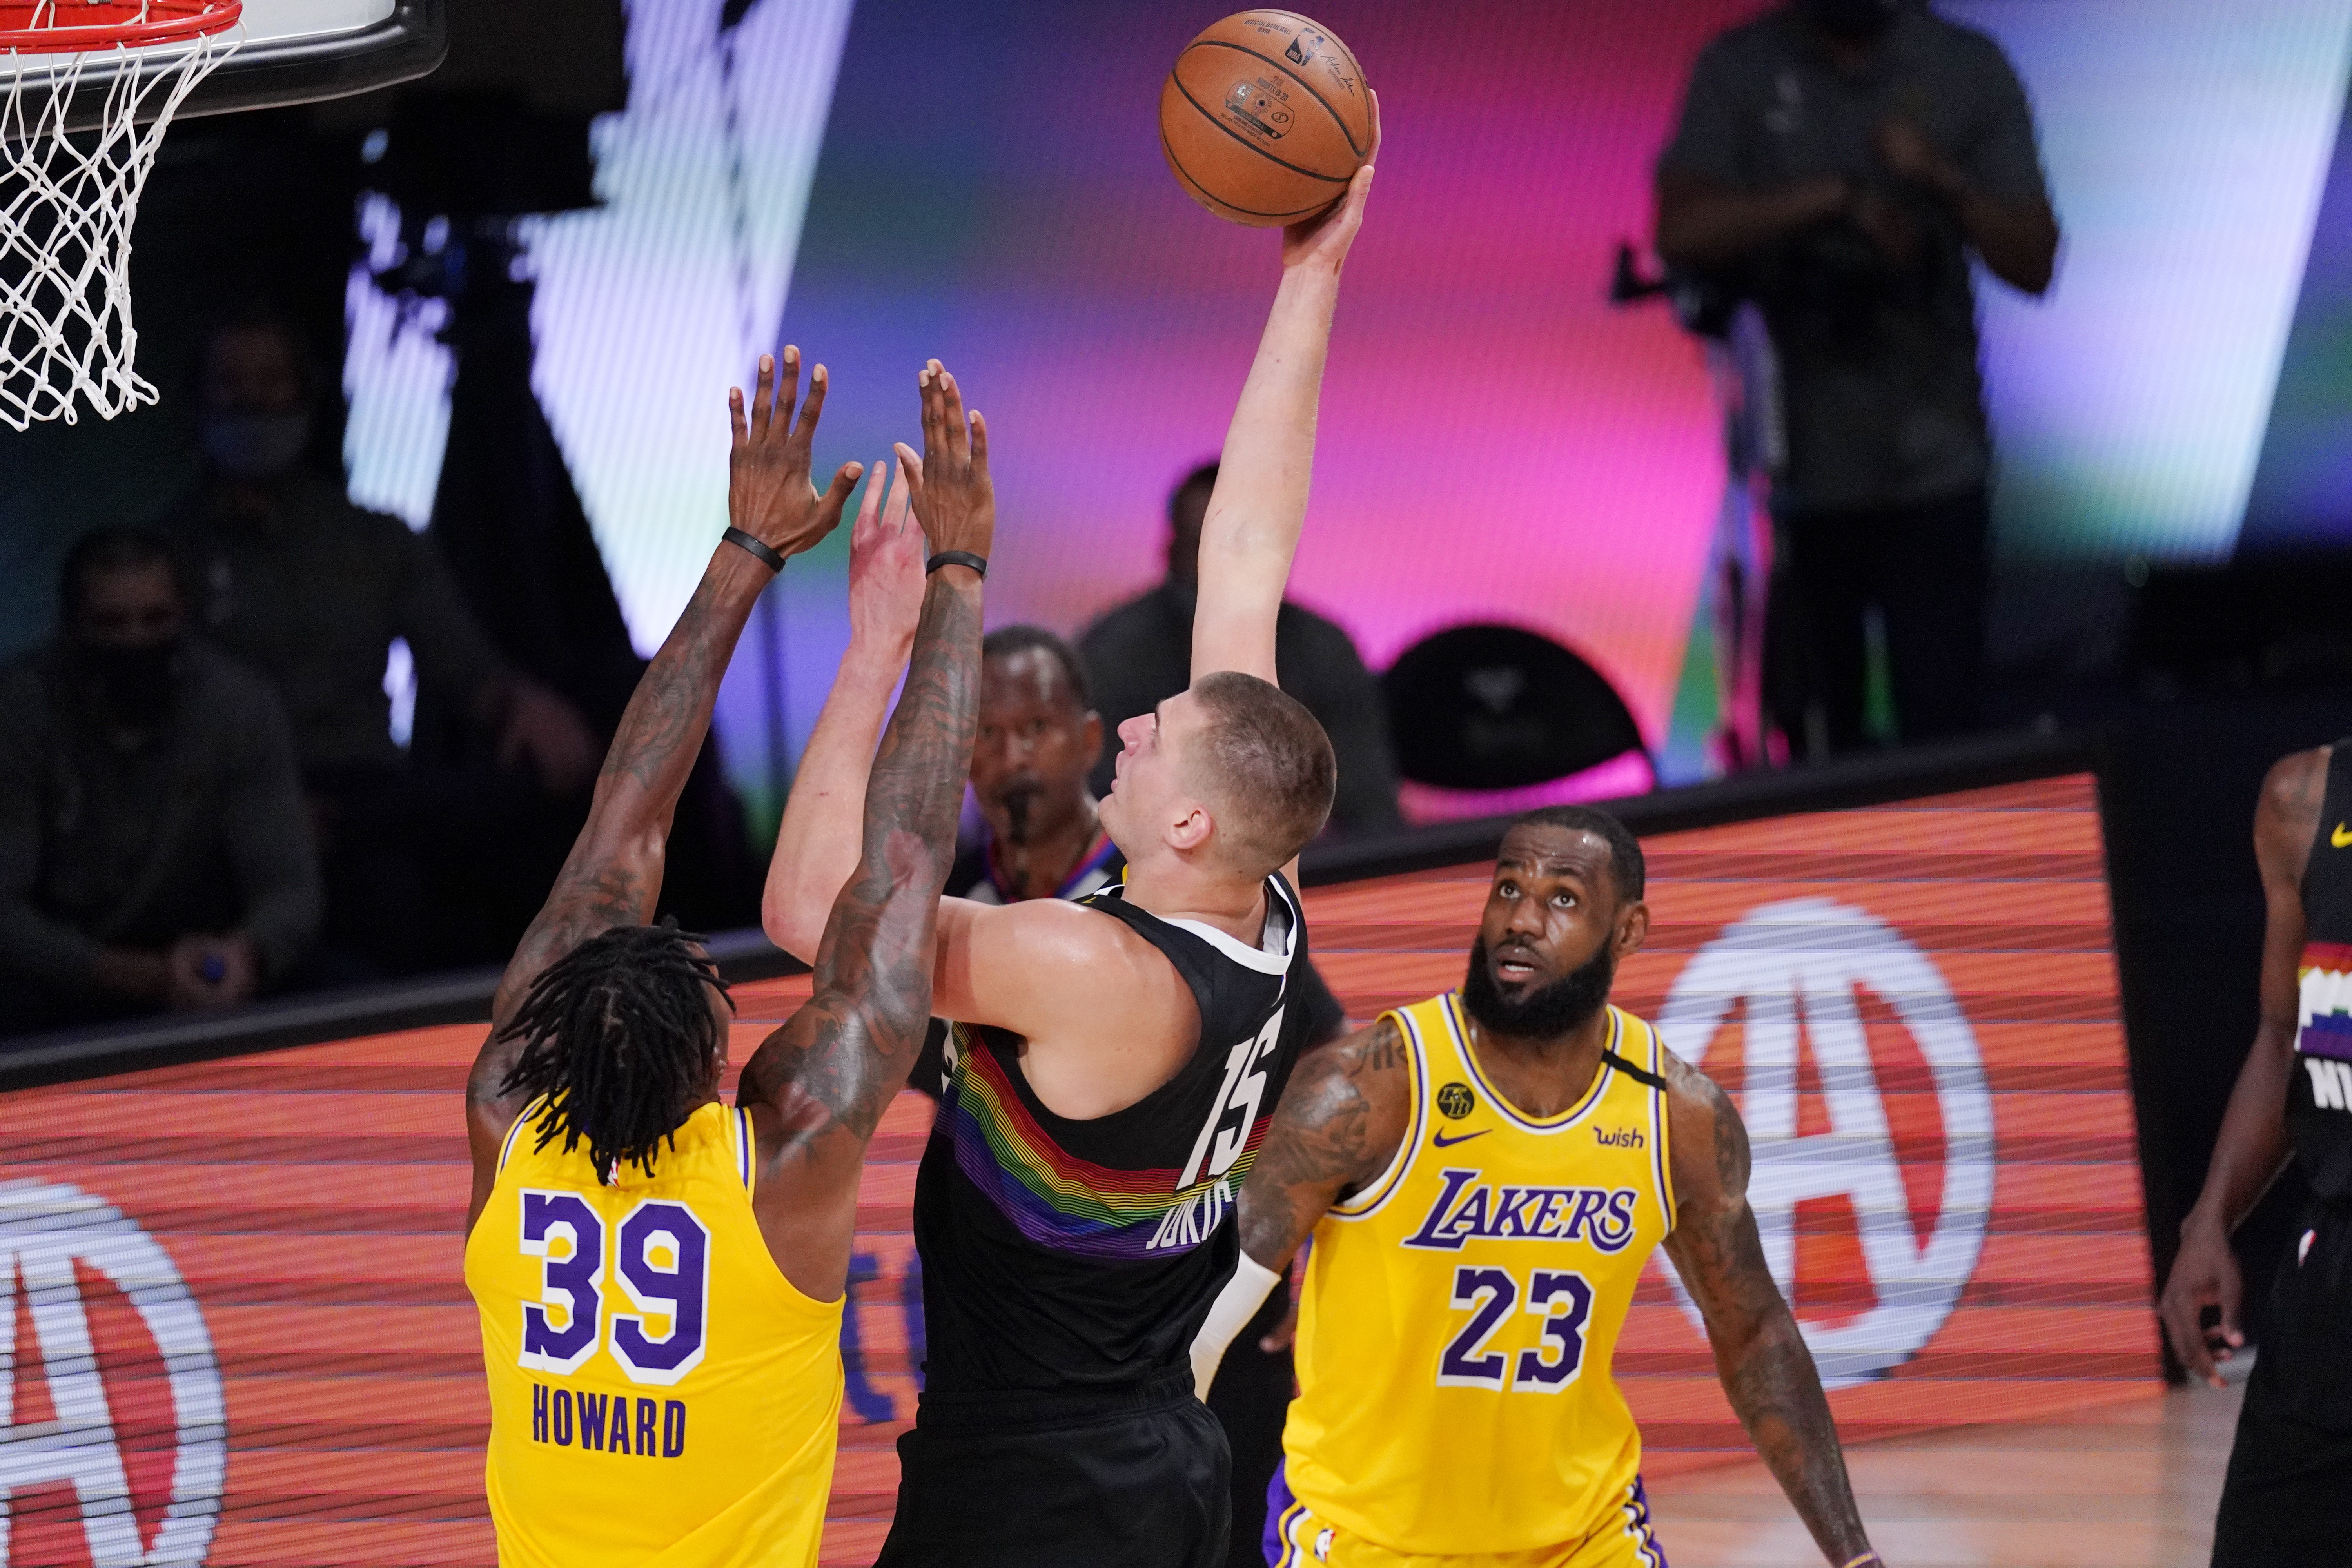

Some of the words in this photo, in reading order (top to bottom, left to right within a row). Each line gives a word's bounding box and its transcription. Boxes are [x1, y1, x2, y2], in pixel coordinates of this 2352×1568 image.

[1279, 26, 1292, 35] BALL
[1287, 49, 1301, 61] NBA
[1176, 1004, 1285, 1190] 15
[1594, 1126, 1643, 1148] wish
[1400, 1166, 1640, 1254] LAKERS
[518, 1187, 711, 1386] 39
[1436, 1265, 1595, 1394] 23
[533, 1383, 686, 1458] HOWARD
